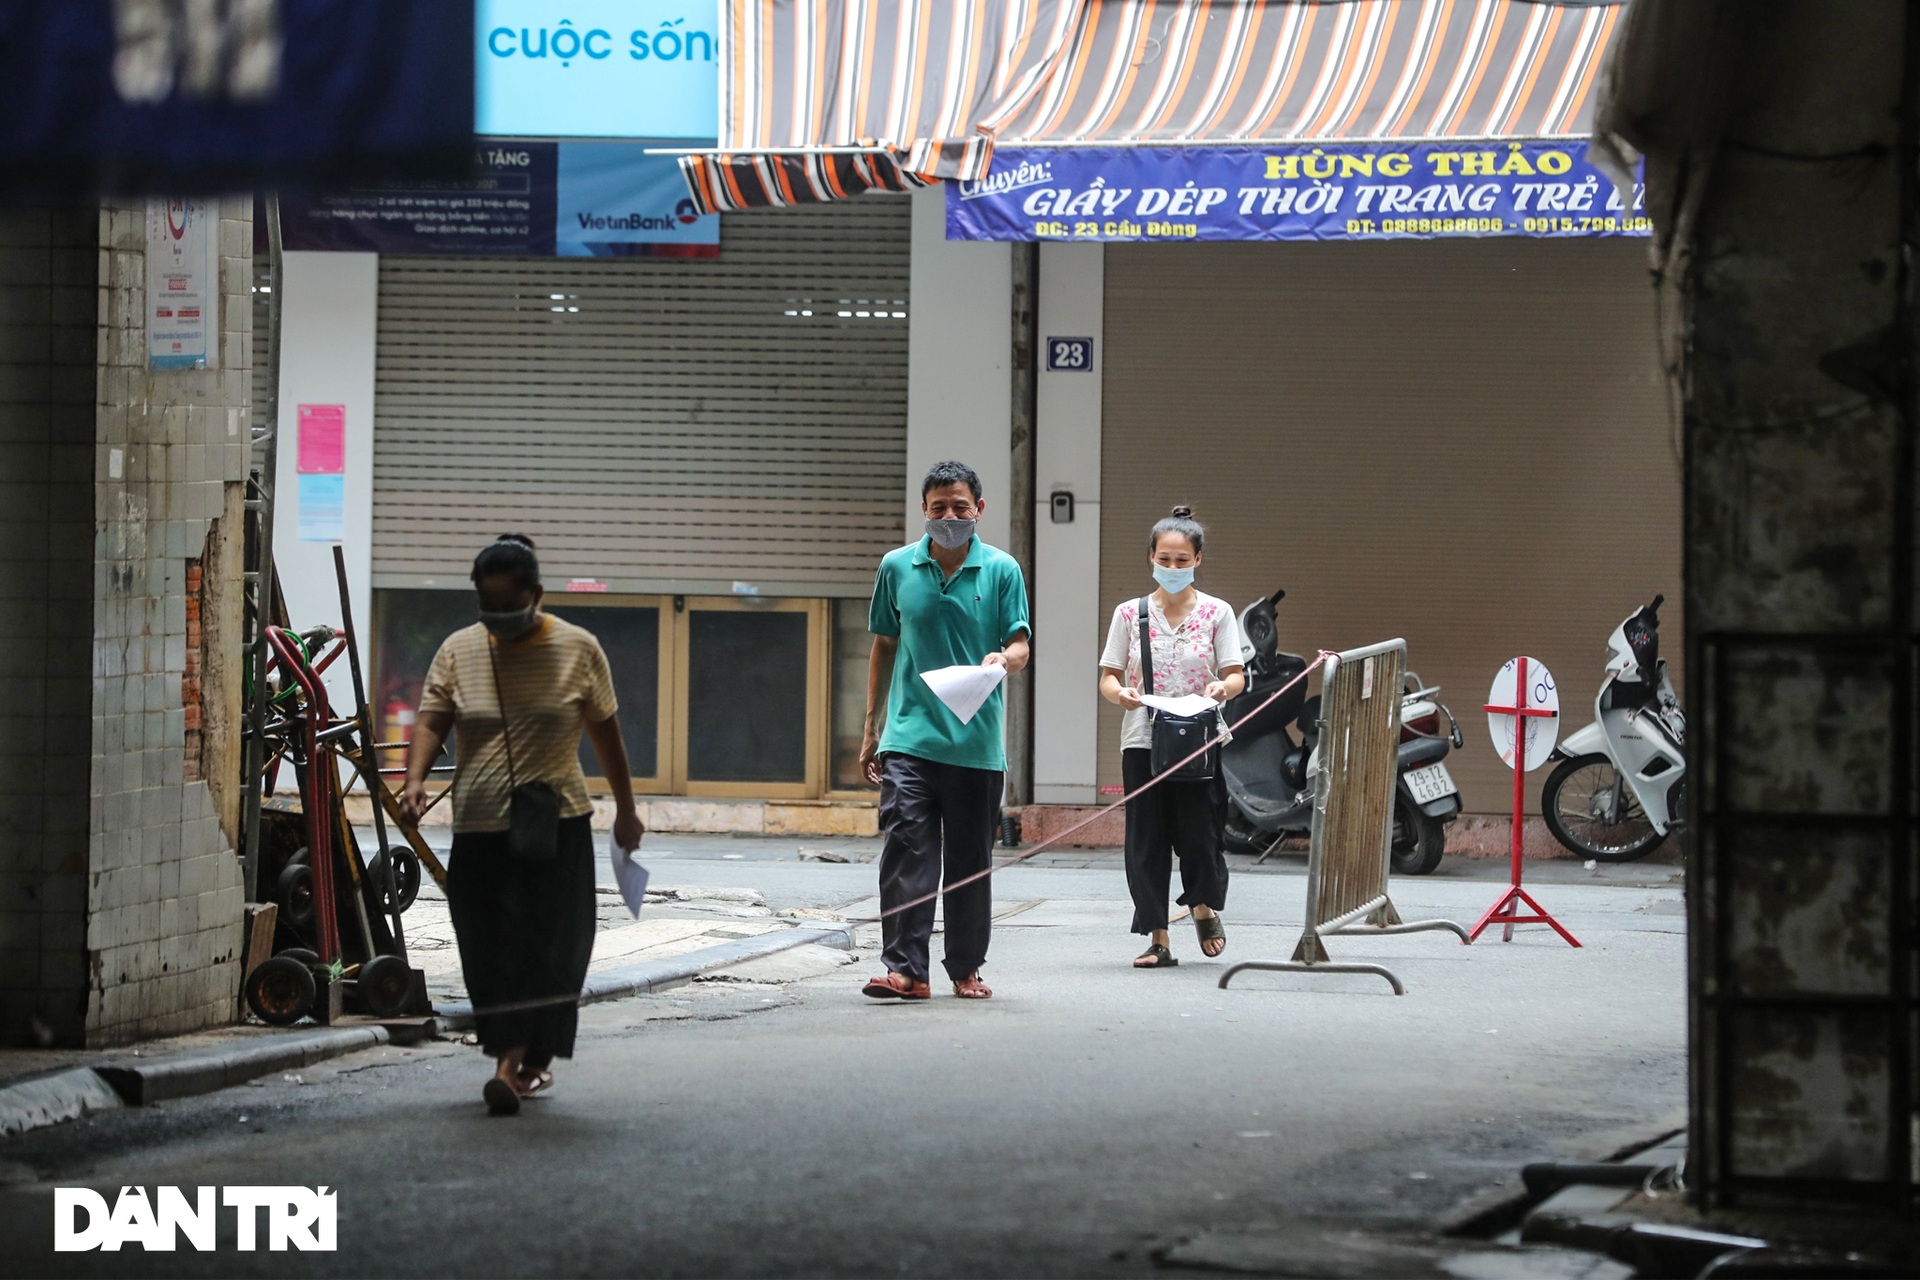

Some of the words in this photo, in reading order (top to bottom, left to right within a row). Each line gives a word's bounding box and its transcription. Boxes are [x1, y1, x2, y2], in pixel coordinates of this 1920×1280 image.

[488, 19, 612, 68] cuộc
[629, 17, 719, 68] sốn
[1263, 149, 1413, 179] HÙNG
[1427, 142, 1574, 177] THẢO
[1022, 176, 1132, 217] GIẦY
[1135, 180, 1228, 217] DÉP
[1236, 179, 1344, 216] THỜI
[1354, 183, 1502, 215] TRANG
[1511, 175, 1599, 213] TRẺ
[1035, 221, 1069, 237] ĐC:
[1074, 221, 1099, 237] 23
[1104, 219, 1142, 237] Cầu
[1346, 219, 1376, 234] ĐT:
[1055, 342, 1084, 367] 23
[1411, 765, 1444, 787] 29-T2
[1419, 779, 1450, 799] 4692
